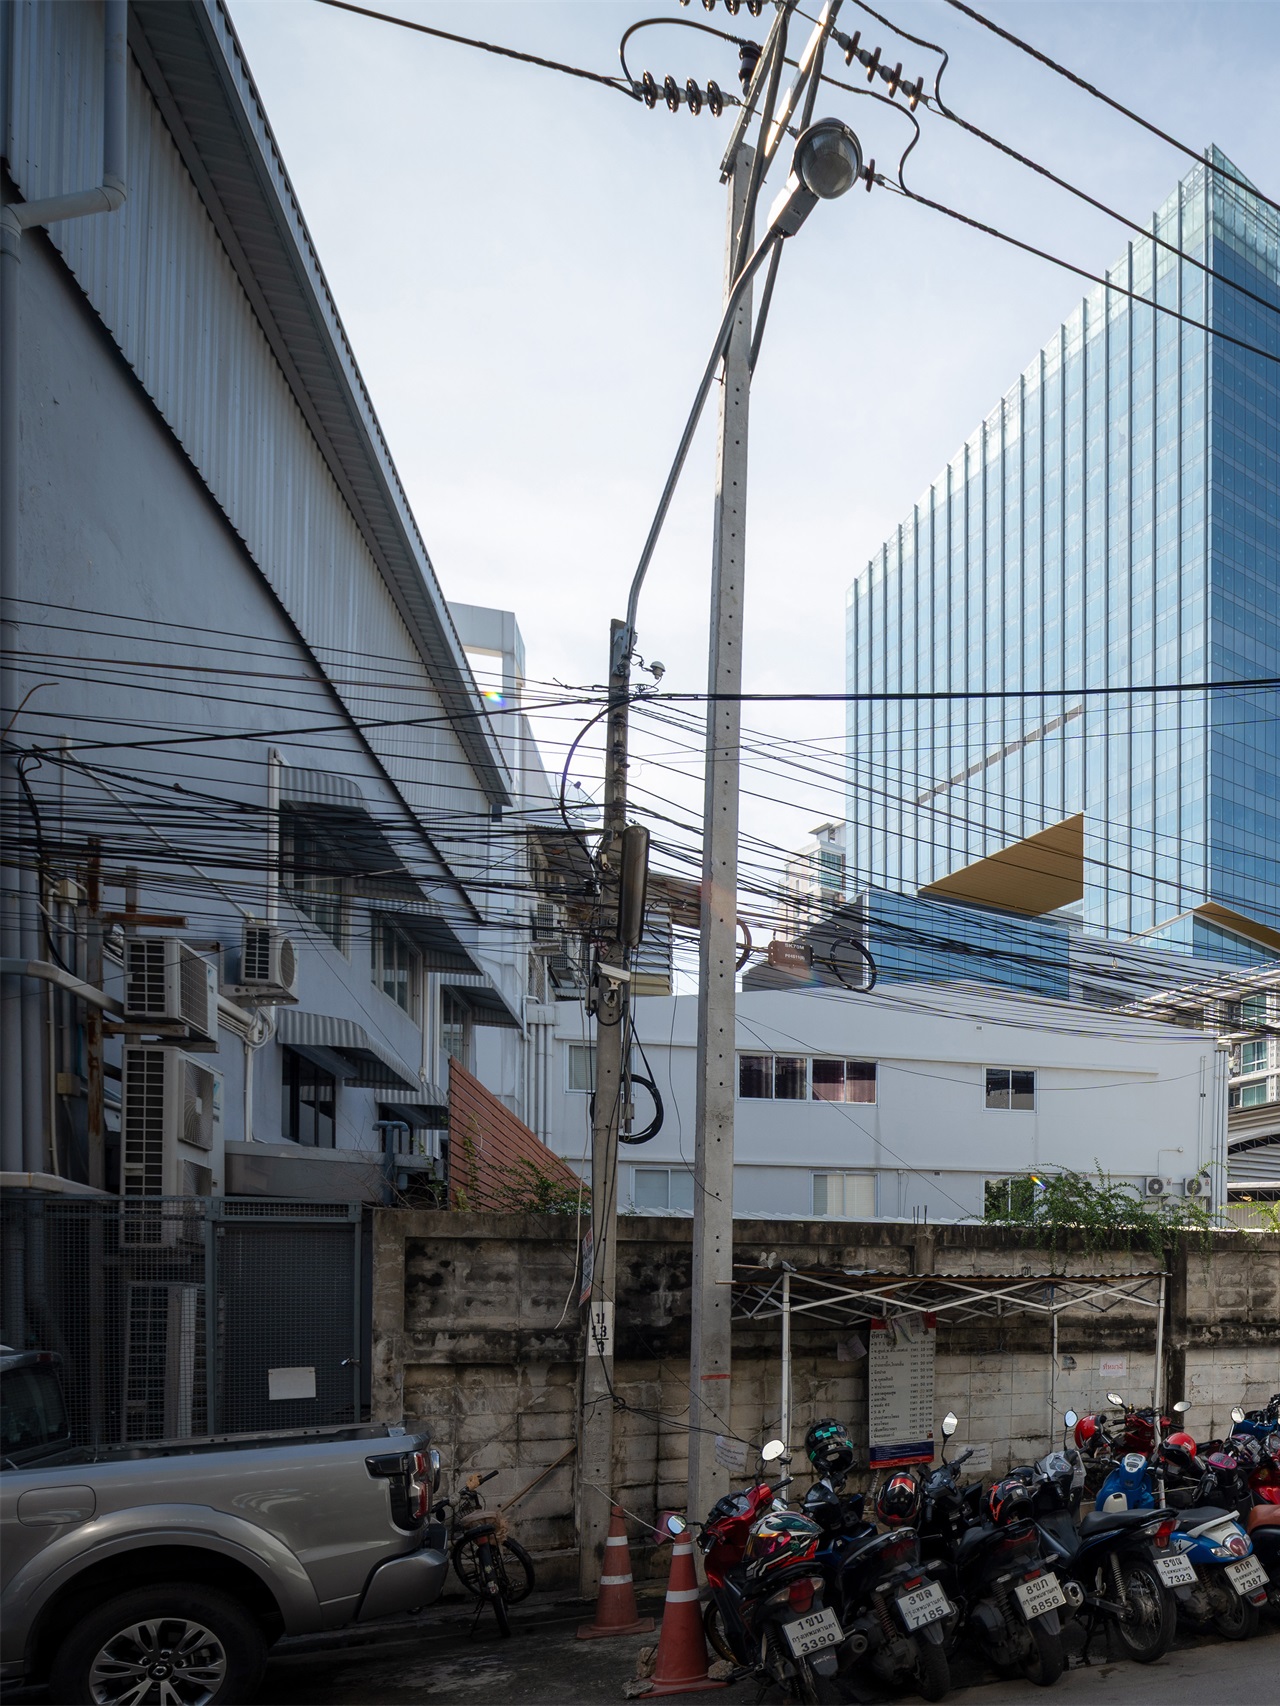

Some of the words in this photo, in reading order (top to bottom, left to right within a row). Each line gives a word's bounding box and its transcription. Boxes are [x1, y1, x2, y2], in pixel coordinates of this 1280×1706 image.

[1161, 1566, 1192, 1576] กรุงเทพมหานคร
[1168, 1573, 1192, 1584] 7323
[1233, 1567, 1262, 1583] กรุงเทพมหานคร
[1240, 1575, 1262, 1590] 7387
[1022, 1586, 1058, 1606] กรุงเทพมหานคร
[1031, 1595, 1060, 1614] 8856
[904, 1596, 945, 1618] กรุงเทพมหานคร
[913, 1605, 944, 1626] 7185
[798, 1613, 824, 1630] 1ขบ
[792, 1622, 837, 1643] กรุงเทพมหานคร
[801, 1633, 836, 1652] 3390
